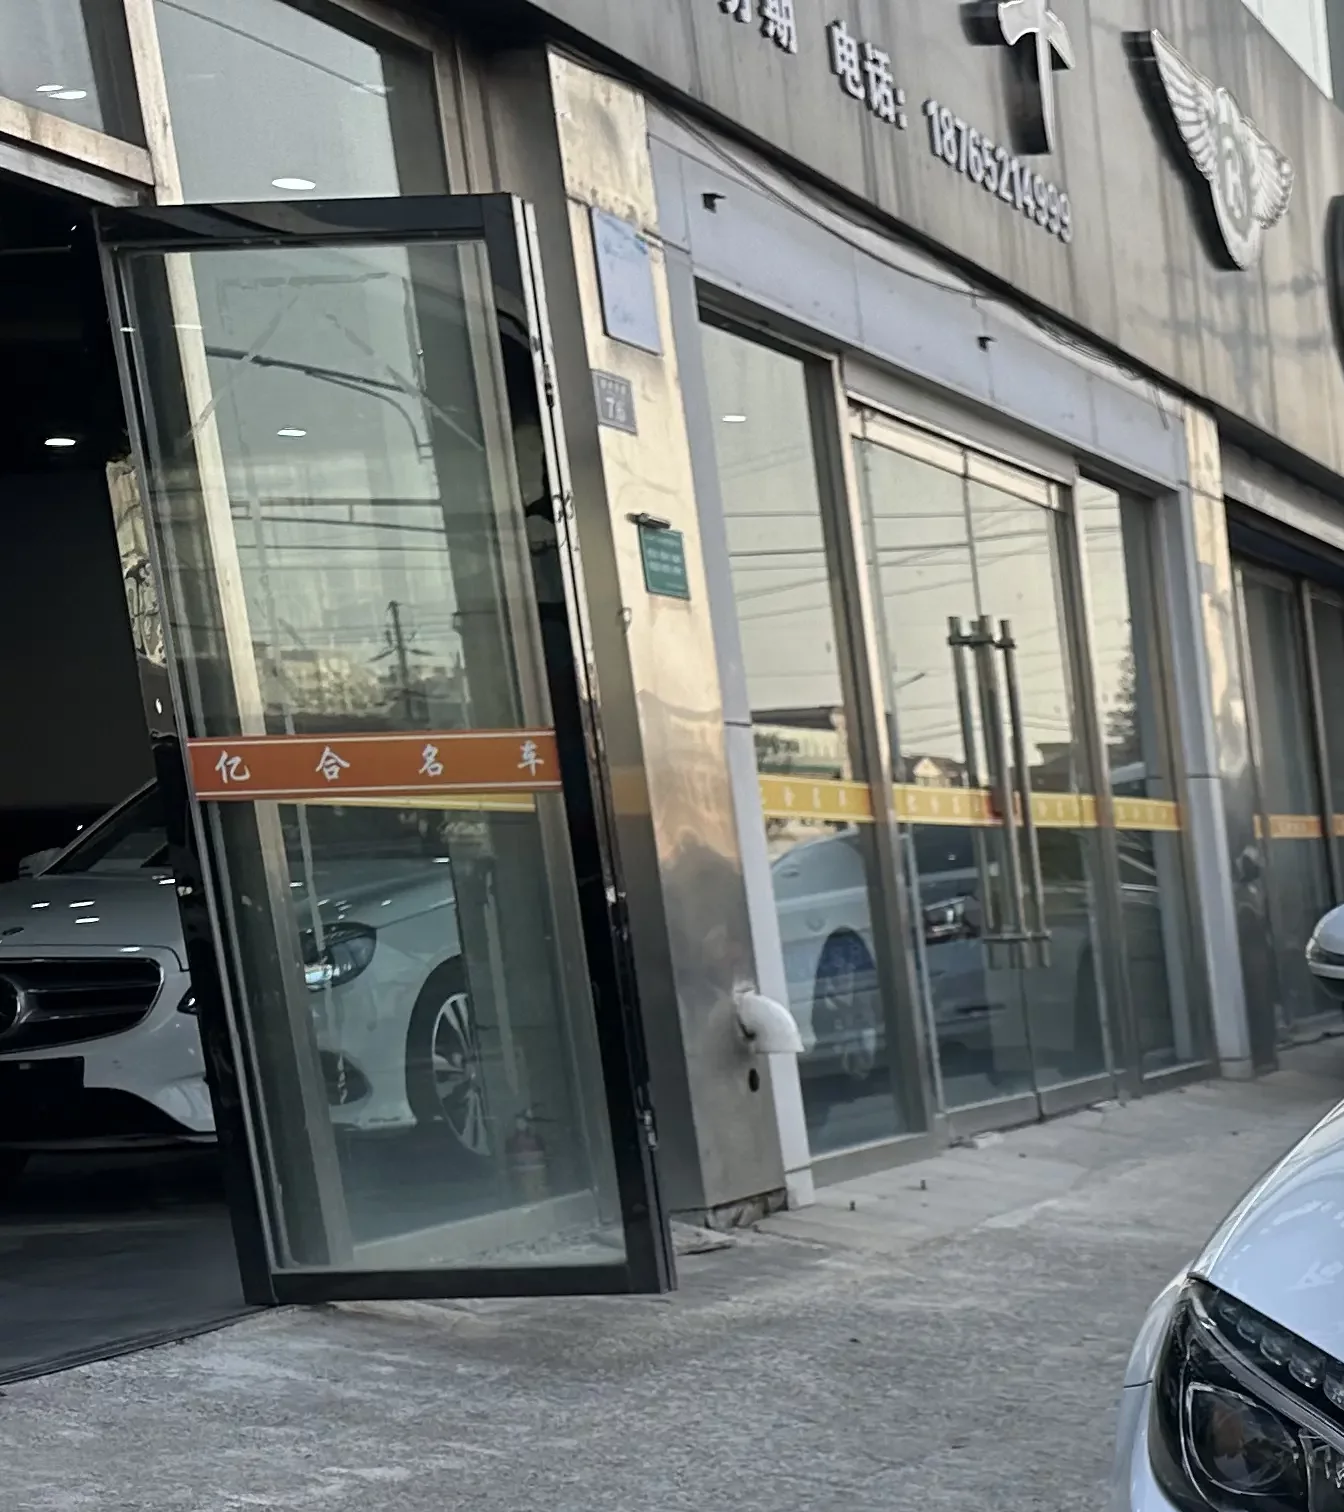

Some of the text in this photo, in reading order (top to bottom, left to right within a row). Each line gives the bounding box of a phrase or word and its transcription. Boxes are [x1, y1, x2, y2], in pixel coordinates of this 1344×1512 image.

[924, 98, 1073, 244] 18765214999
[214, 739, 545, 784] 亿合名车
